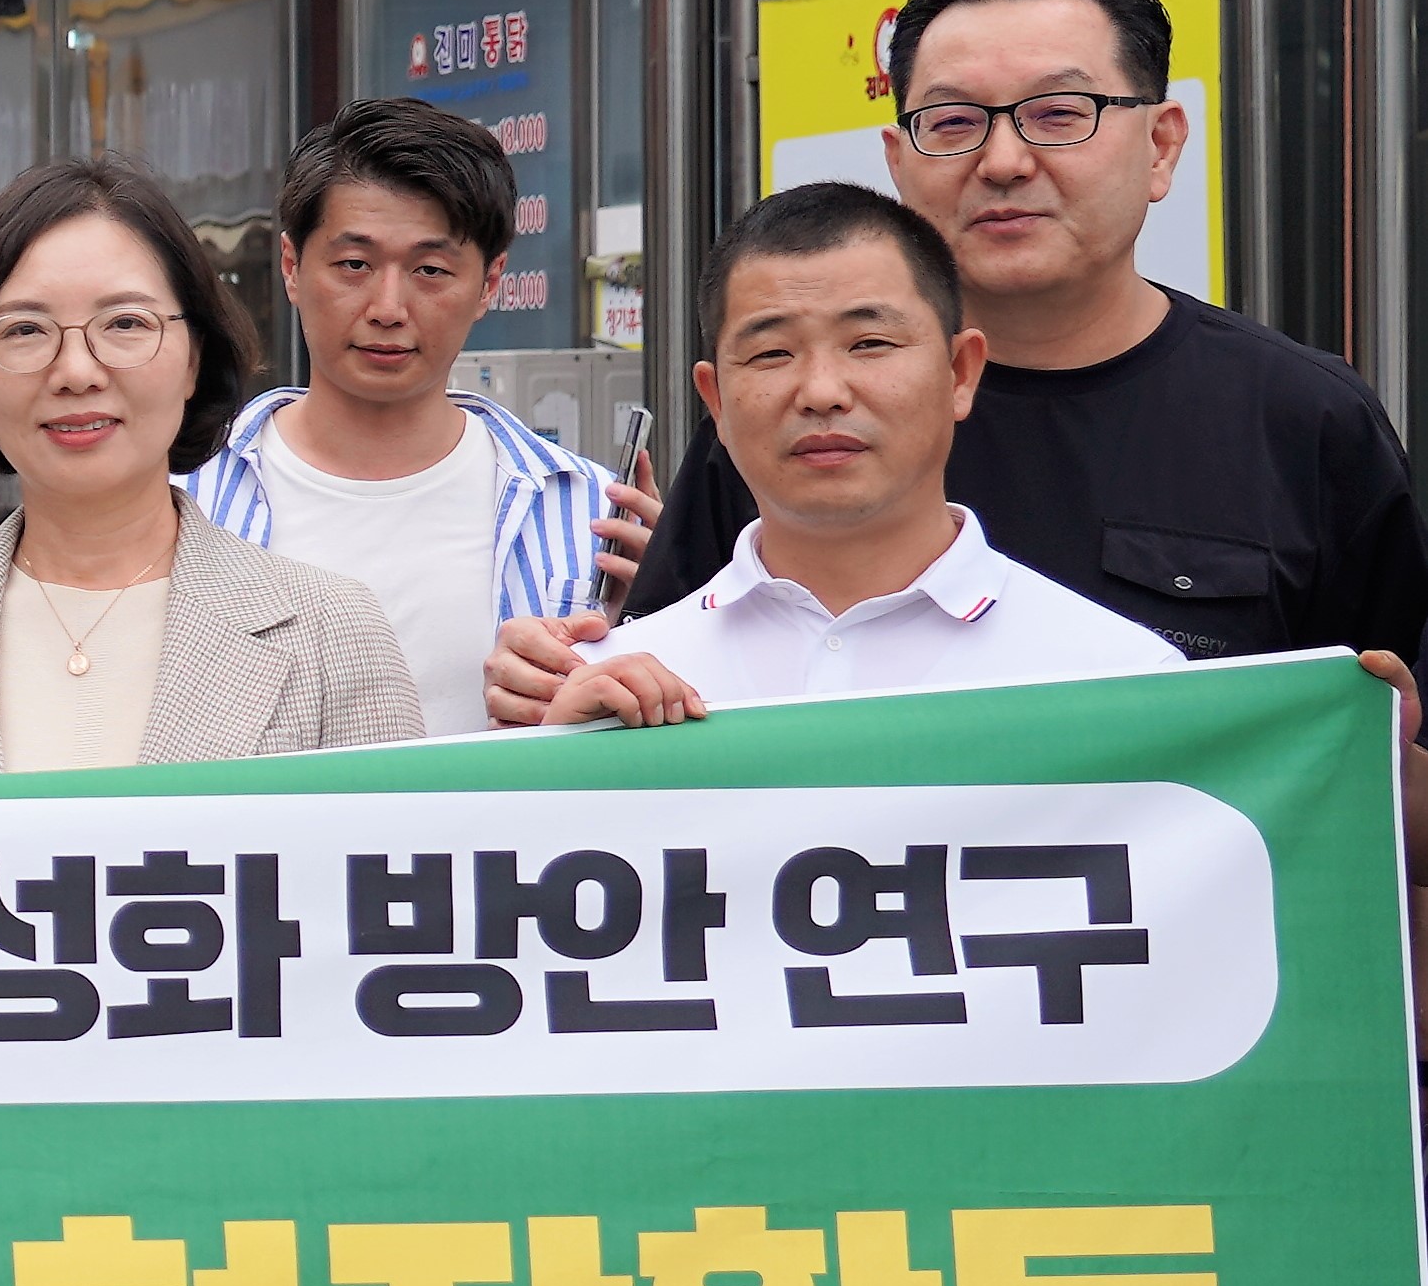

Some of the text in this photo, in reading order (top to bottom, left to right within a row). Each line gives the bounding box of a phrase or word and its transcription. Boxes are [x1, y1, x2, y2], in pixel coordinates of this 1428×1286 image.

[433, 10, 529, 76] 진미통닭
[605, 307, 644, 337] 정기휴
[346, 847, 727, 1038] 방안
[770, 842, 1150, 1027] 연구
